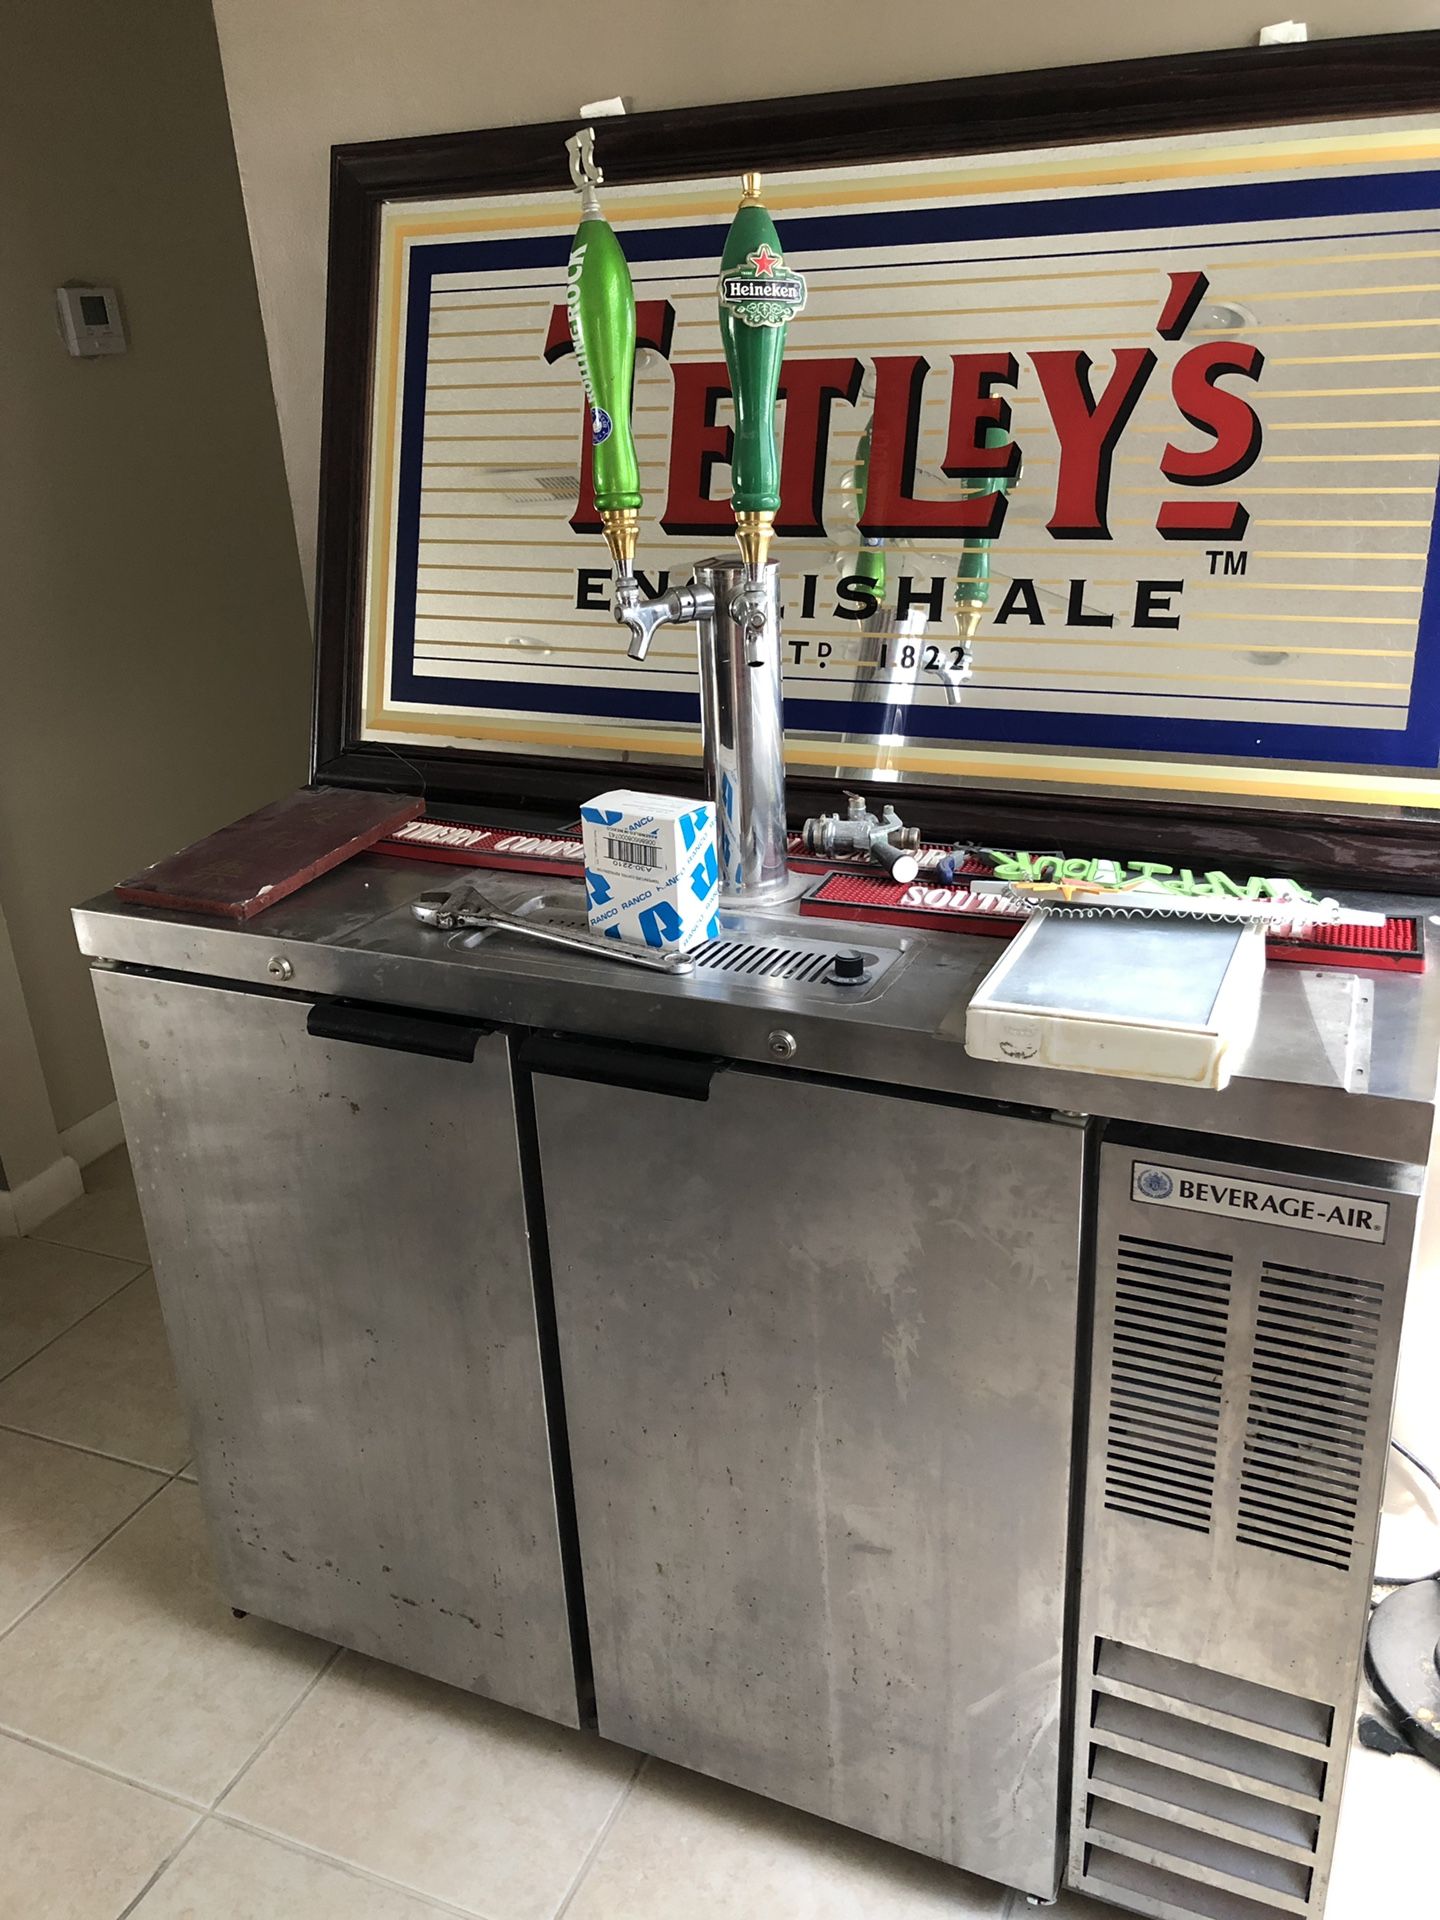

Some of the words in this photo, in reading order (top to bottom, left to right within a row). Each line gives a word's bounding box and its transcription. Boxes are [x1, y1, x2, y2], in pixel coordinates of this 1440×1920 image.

[566, 244, 588, 320] ROCK
[730, 282, 797, 298] Heineken
[1206, 551, 1248, 576] TM
[993, 577, 1185, 631] ALE
[880, 643, 966, 671] 1822
[613, 860, 652, 873] A30-2210
[590, 908, 619, 927] RANCO
[621, 890, 653, 910] RANCO
[900, 886, 1032, 916] SOUTH
